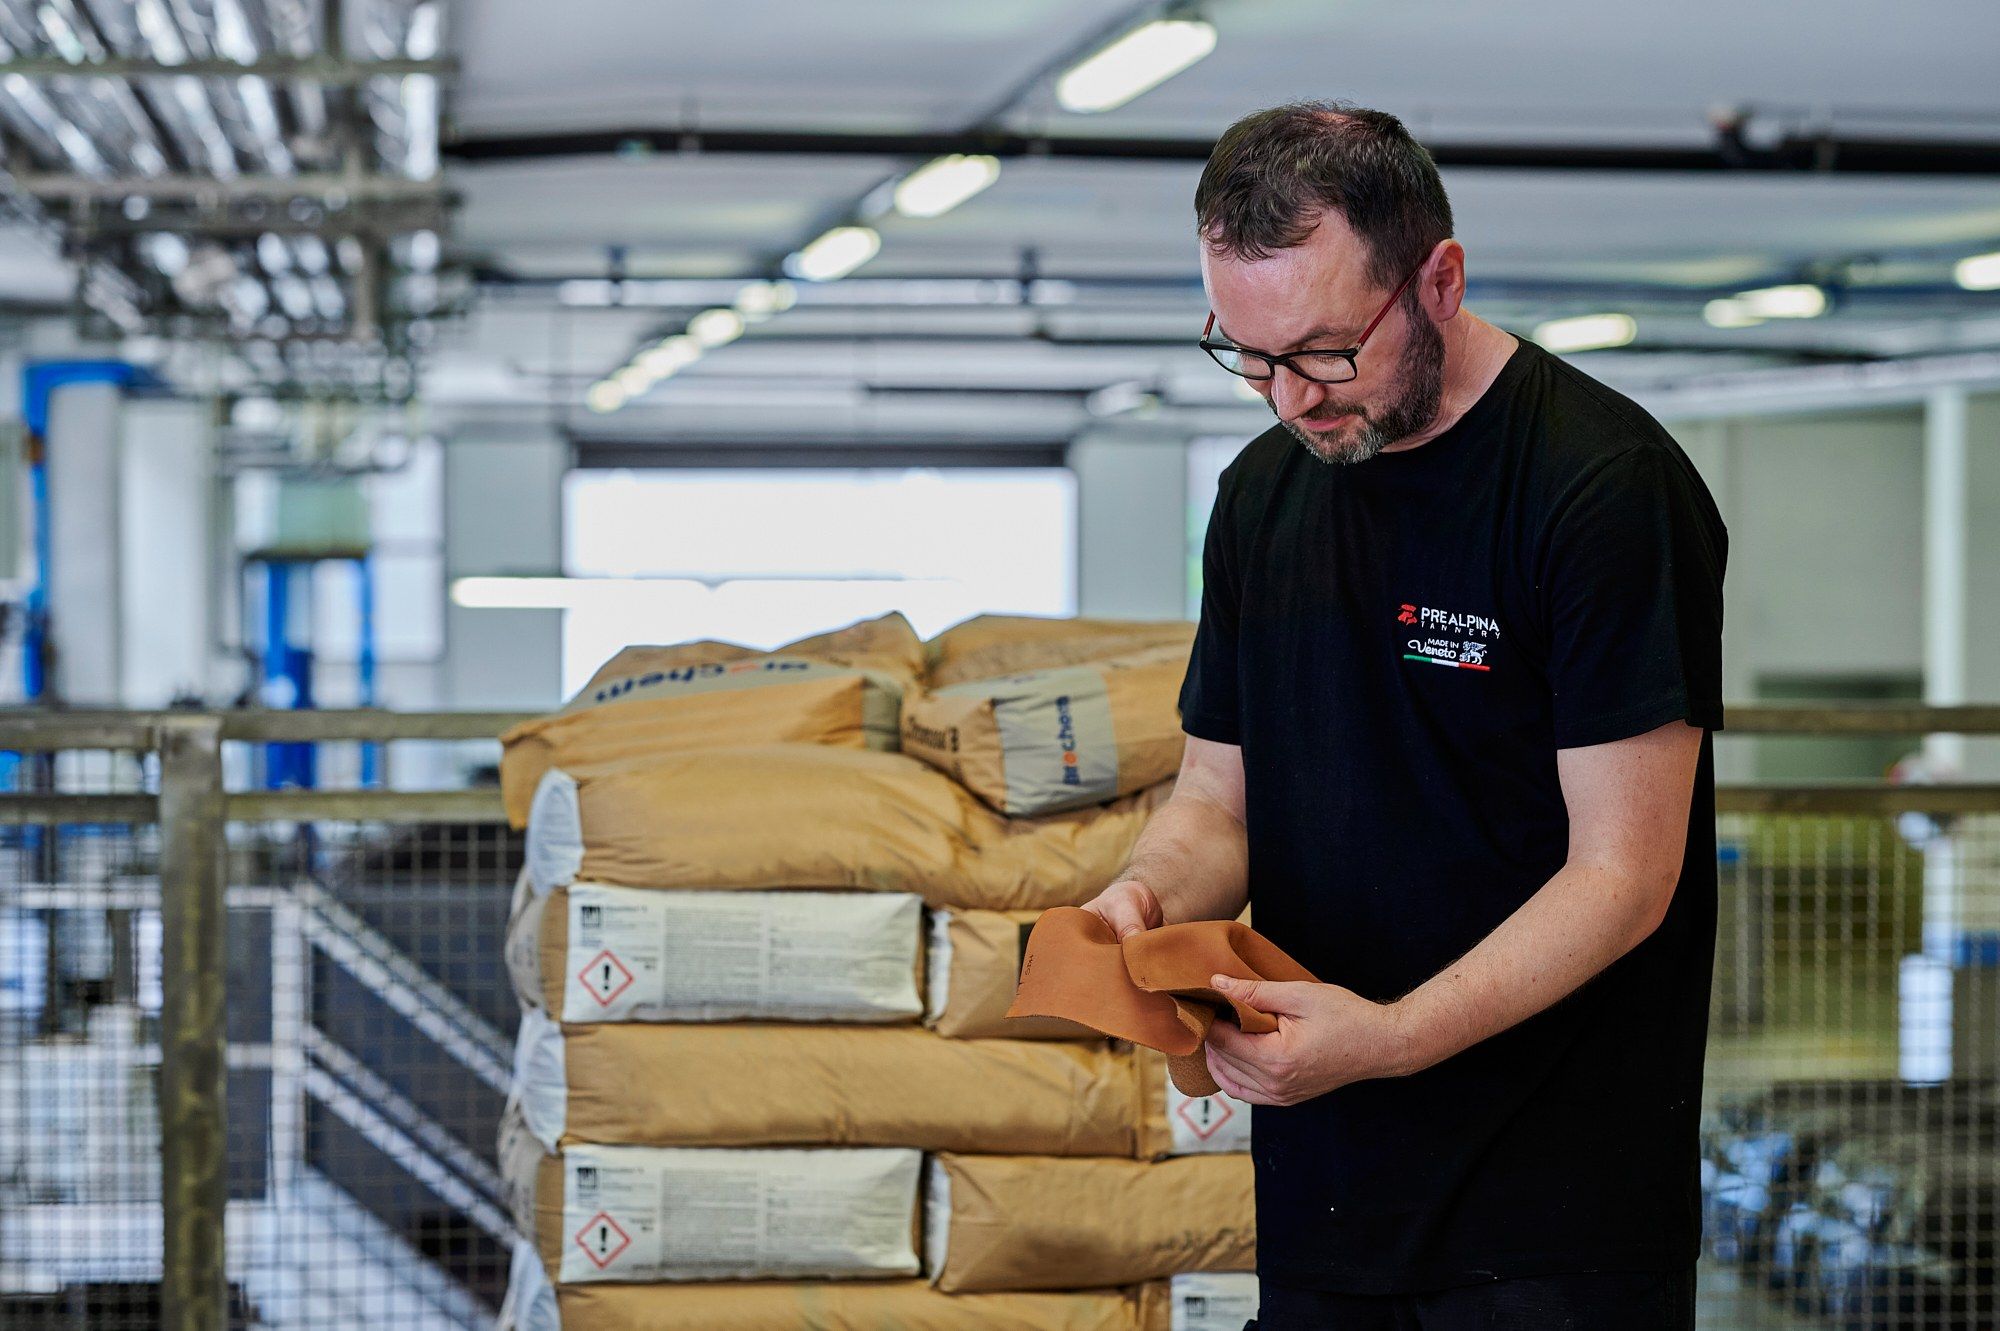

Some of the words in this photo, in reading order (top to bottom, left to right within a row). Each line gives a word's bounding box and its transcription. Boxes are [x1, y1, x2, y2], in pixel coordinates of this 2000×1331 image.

[1421, 607, 1500, 632] PREALPINA
[1421, 621, 1501, 640] TANNERY
[1407, 640, 1457, 659] Veneto
[1428, 638, 1449, 649] MADE
[1450, 641, 1460, 649] IN
